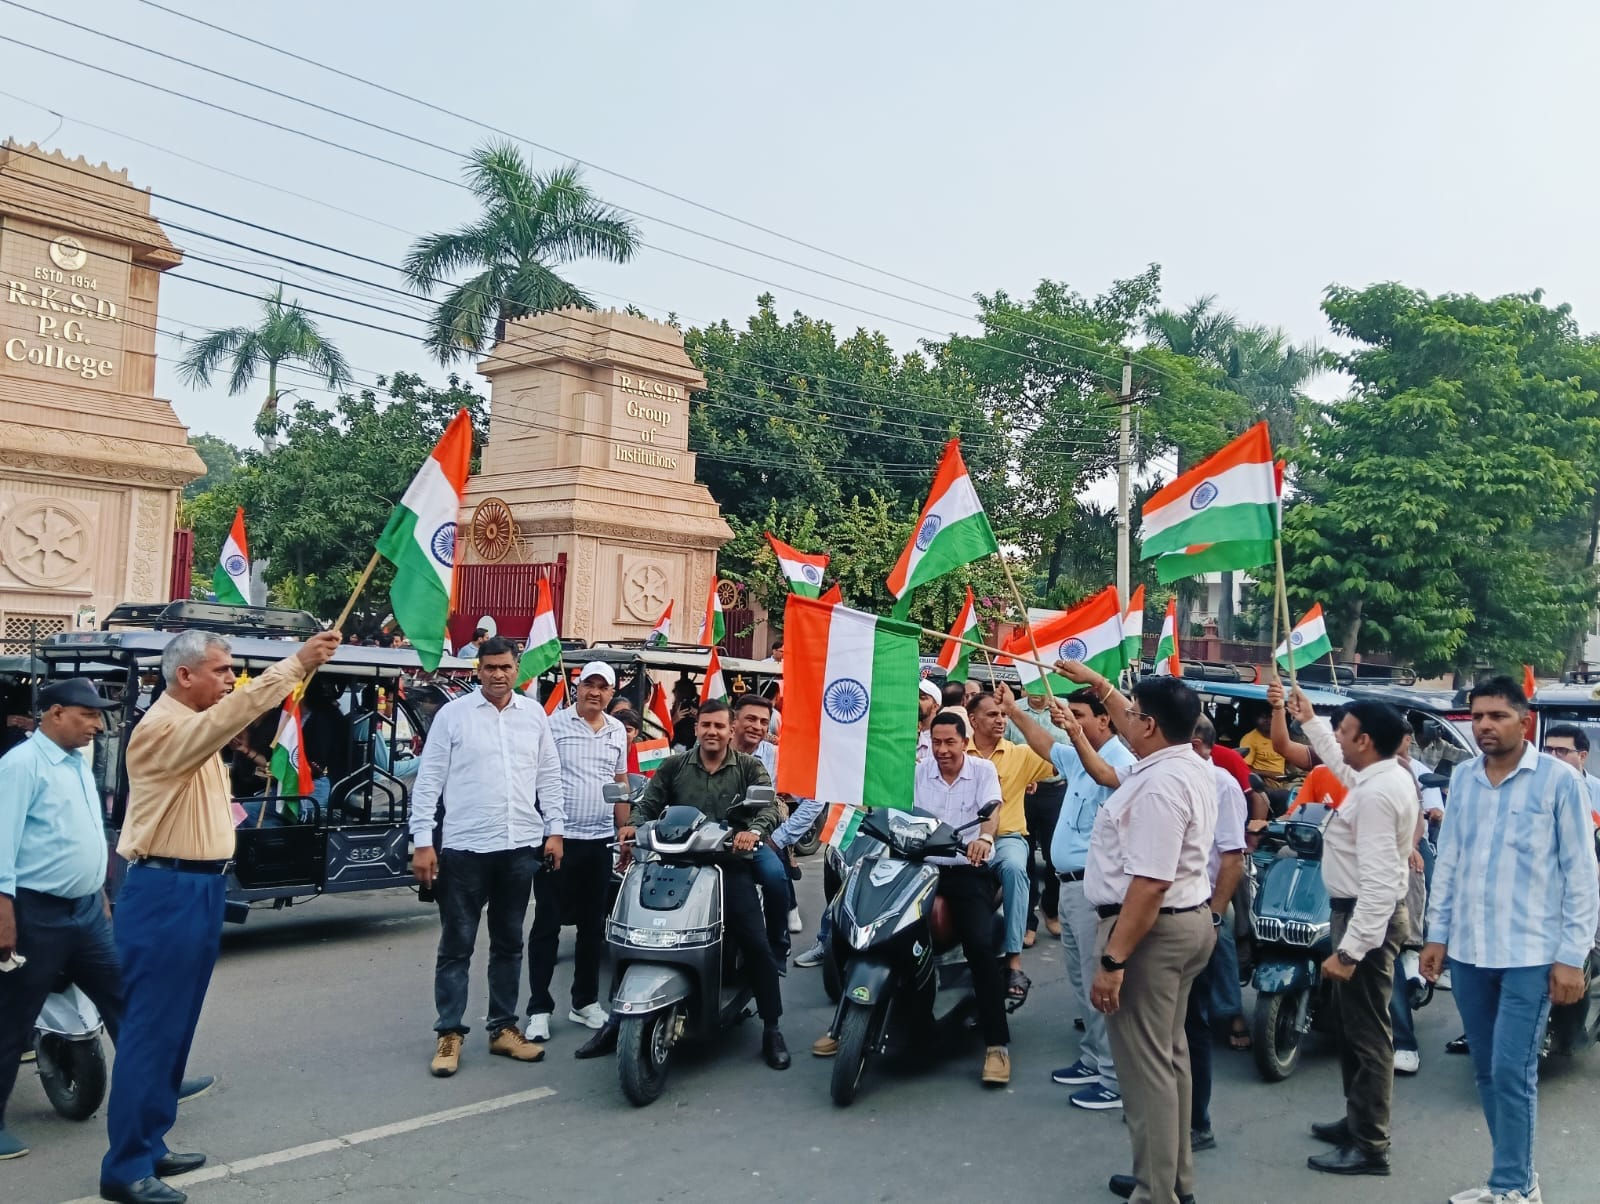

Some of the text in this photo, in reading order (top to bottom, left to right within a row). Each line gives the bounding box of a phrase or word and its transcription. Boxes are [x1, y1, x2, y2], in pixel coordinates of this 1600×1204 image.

[35, 267, 97, 291] ESTD. 1954
[7, 280, 121, 323] R.K.S.D.
[37, 314, 91, 345] P.G.
[5, 338, 113, 379] College
[620, 375, 680, 404] R.K.S.D.
[627, 400, 671, 427] Group
[641, 428, 656, 443] of
[615, 444, 677, 469] Institutions
